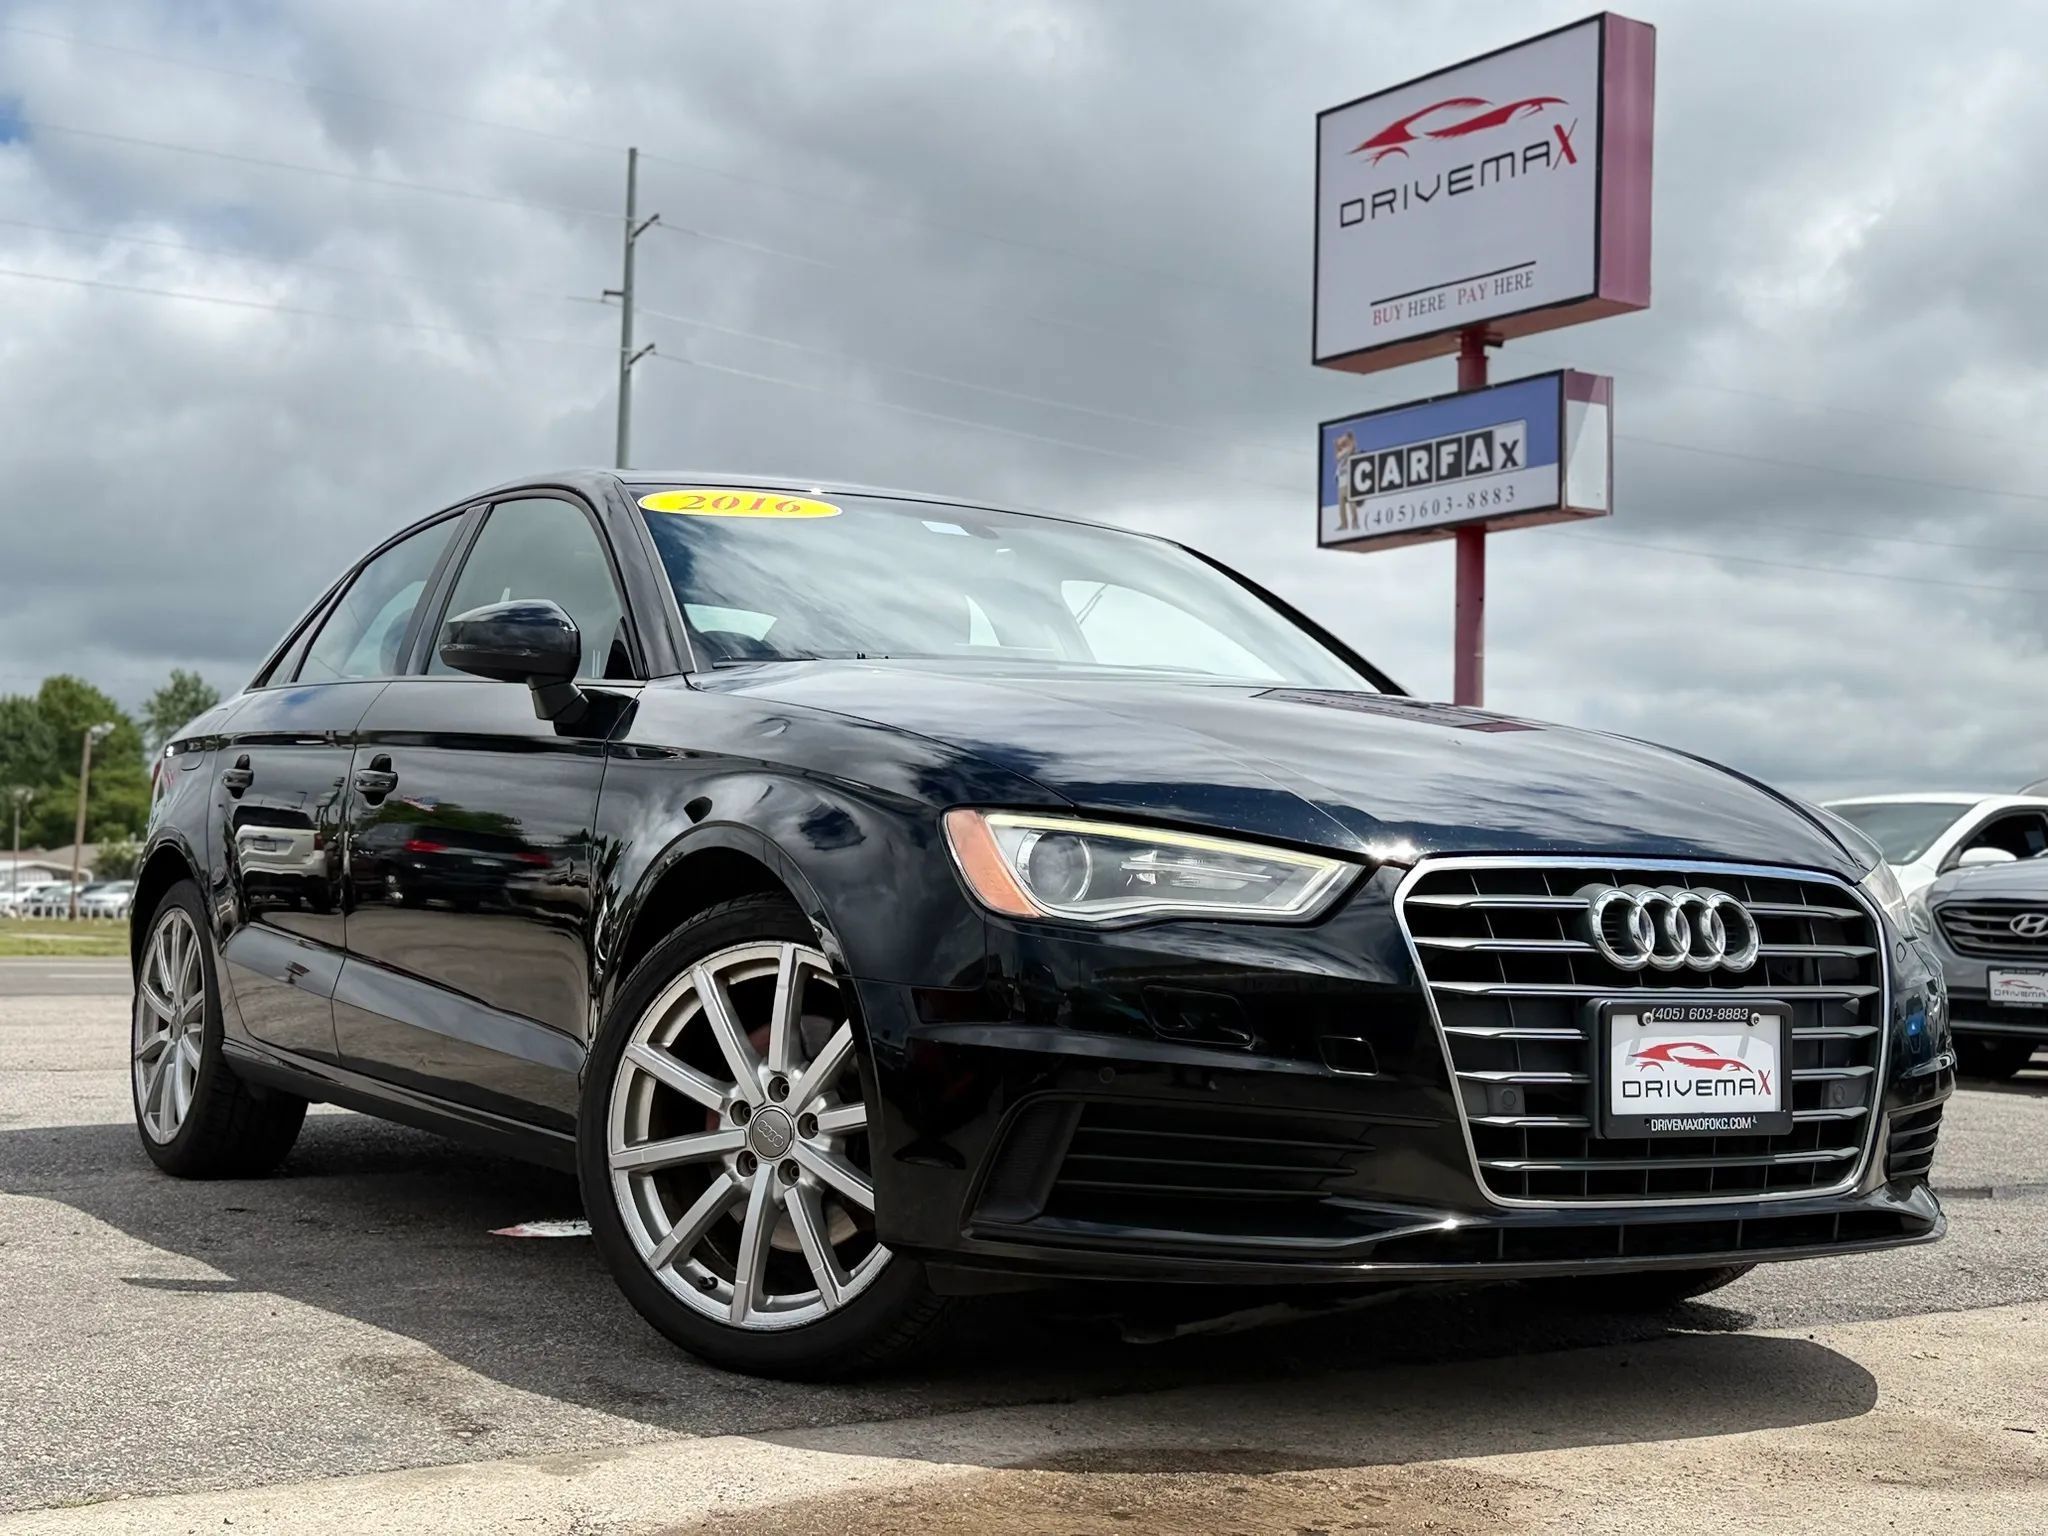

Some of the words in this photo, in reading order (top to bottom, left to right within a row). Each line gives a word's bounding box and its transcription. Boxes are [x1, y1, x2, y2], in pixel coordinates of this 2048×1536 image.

[1339, 117, 1578, 228] DRIVEMAX
[1373, 304, 1404, 326] BUY
[1408, 293, 1446, 318] HERE
[1457, 282, 1488, 305] PAY
[1494, 270, 1534, 296] HERE
[1353, 436, 1520, 492] CARFAX
[678, 495, 801, 513] 2016
[1364, 485, 1515, 530] (405)603-8883
[1652, 1007, 1685, 1020] (405)
[1689, 1007, 1749, 1020] 603-8883
[1622, 1069, 1771, 1098] DRIVEMAX
[1651, 1117, 1752, 1131] DRIVEMAXOFOKC.COM
